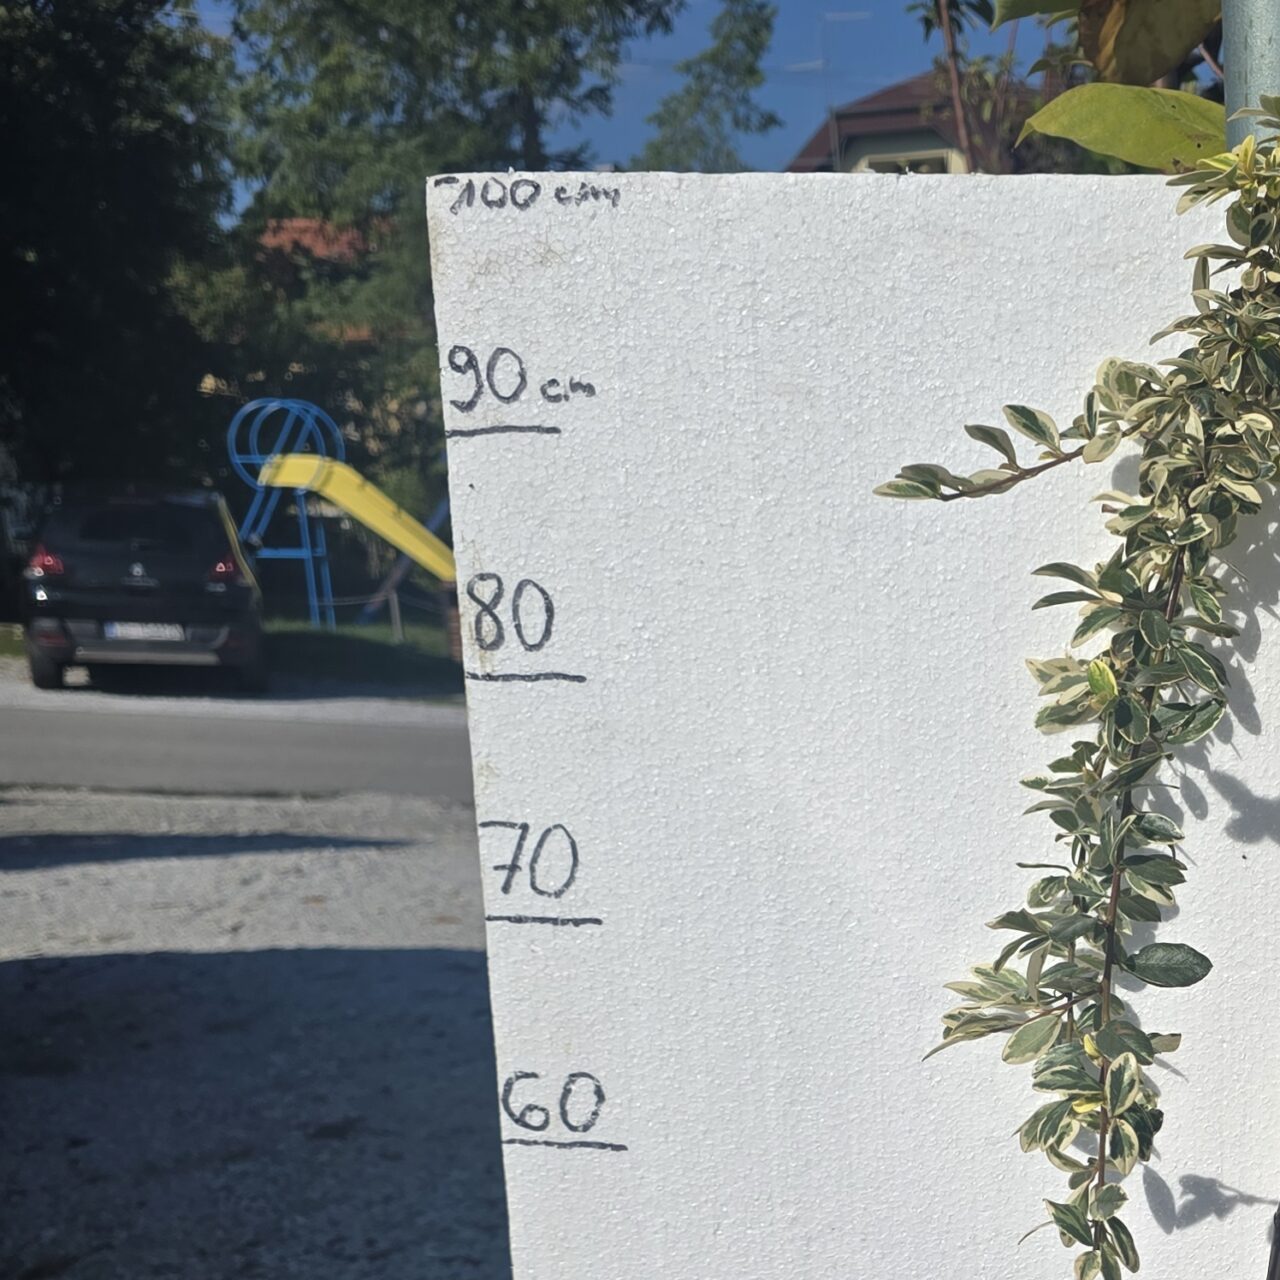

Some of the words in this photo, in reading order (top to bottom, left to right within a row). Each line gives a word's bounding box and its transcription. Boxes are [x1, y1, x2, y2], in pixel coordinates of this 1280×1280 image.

[448, 177, 541, 214] 100
[448, 345, 527, 413] 90
[540, 377, 596, 403] cm
[466, 572, 555, 652] 80
[479, 820, 579, 898] 70
[501, 1070, 606, 1133] 60
